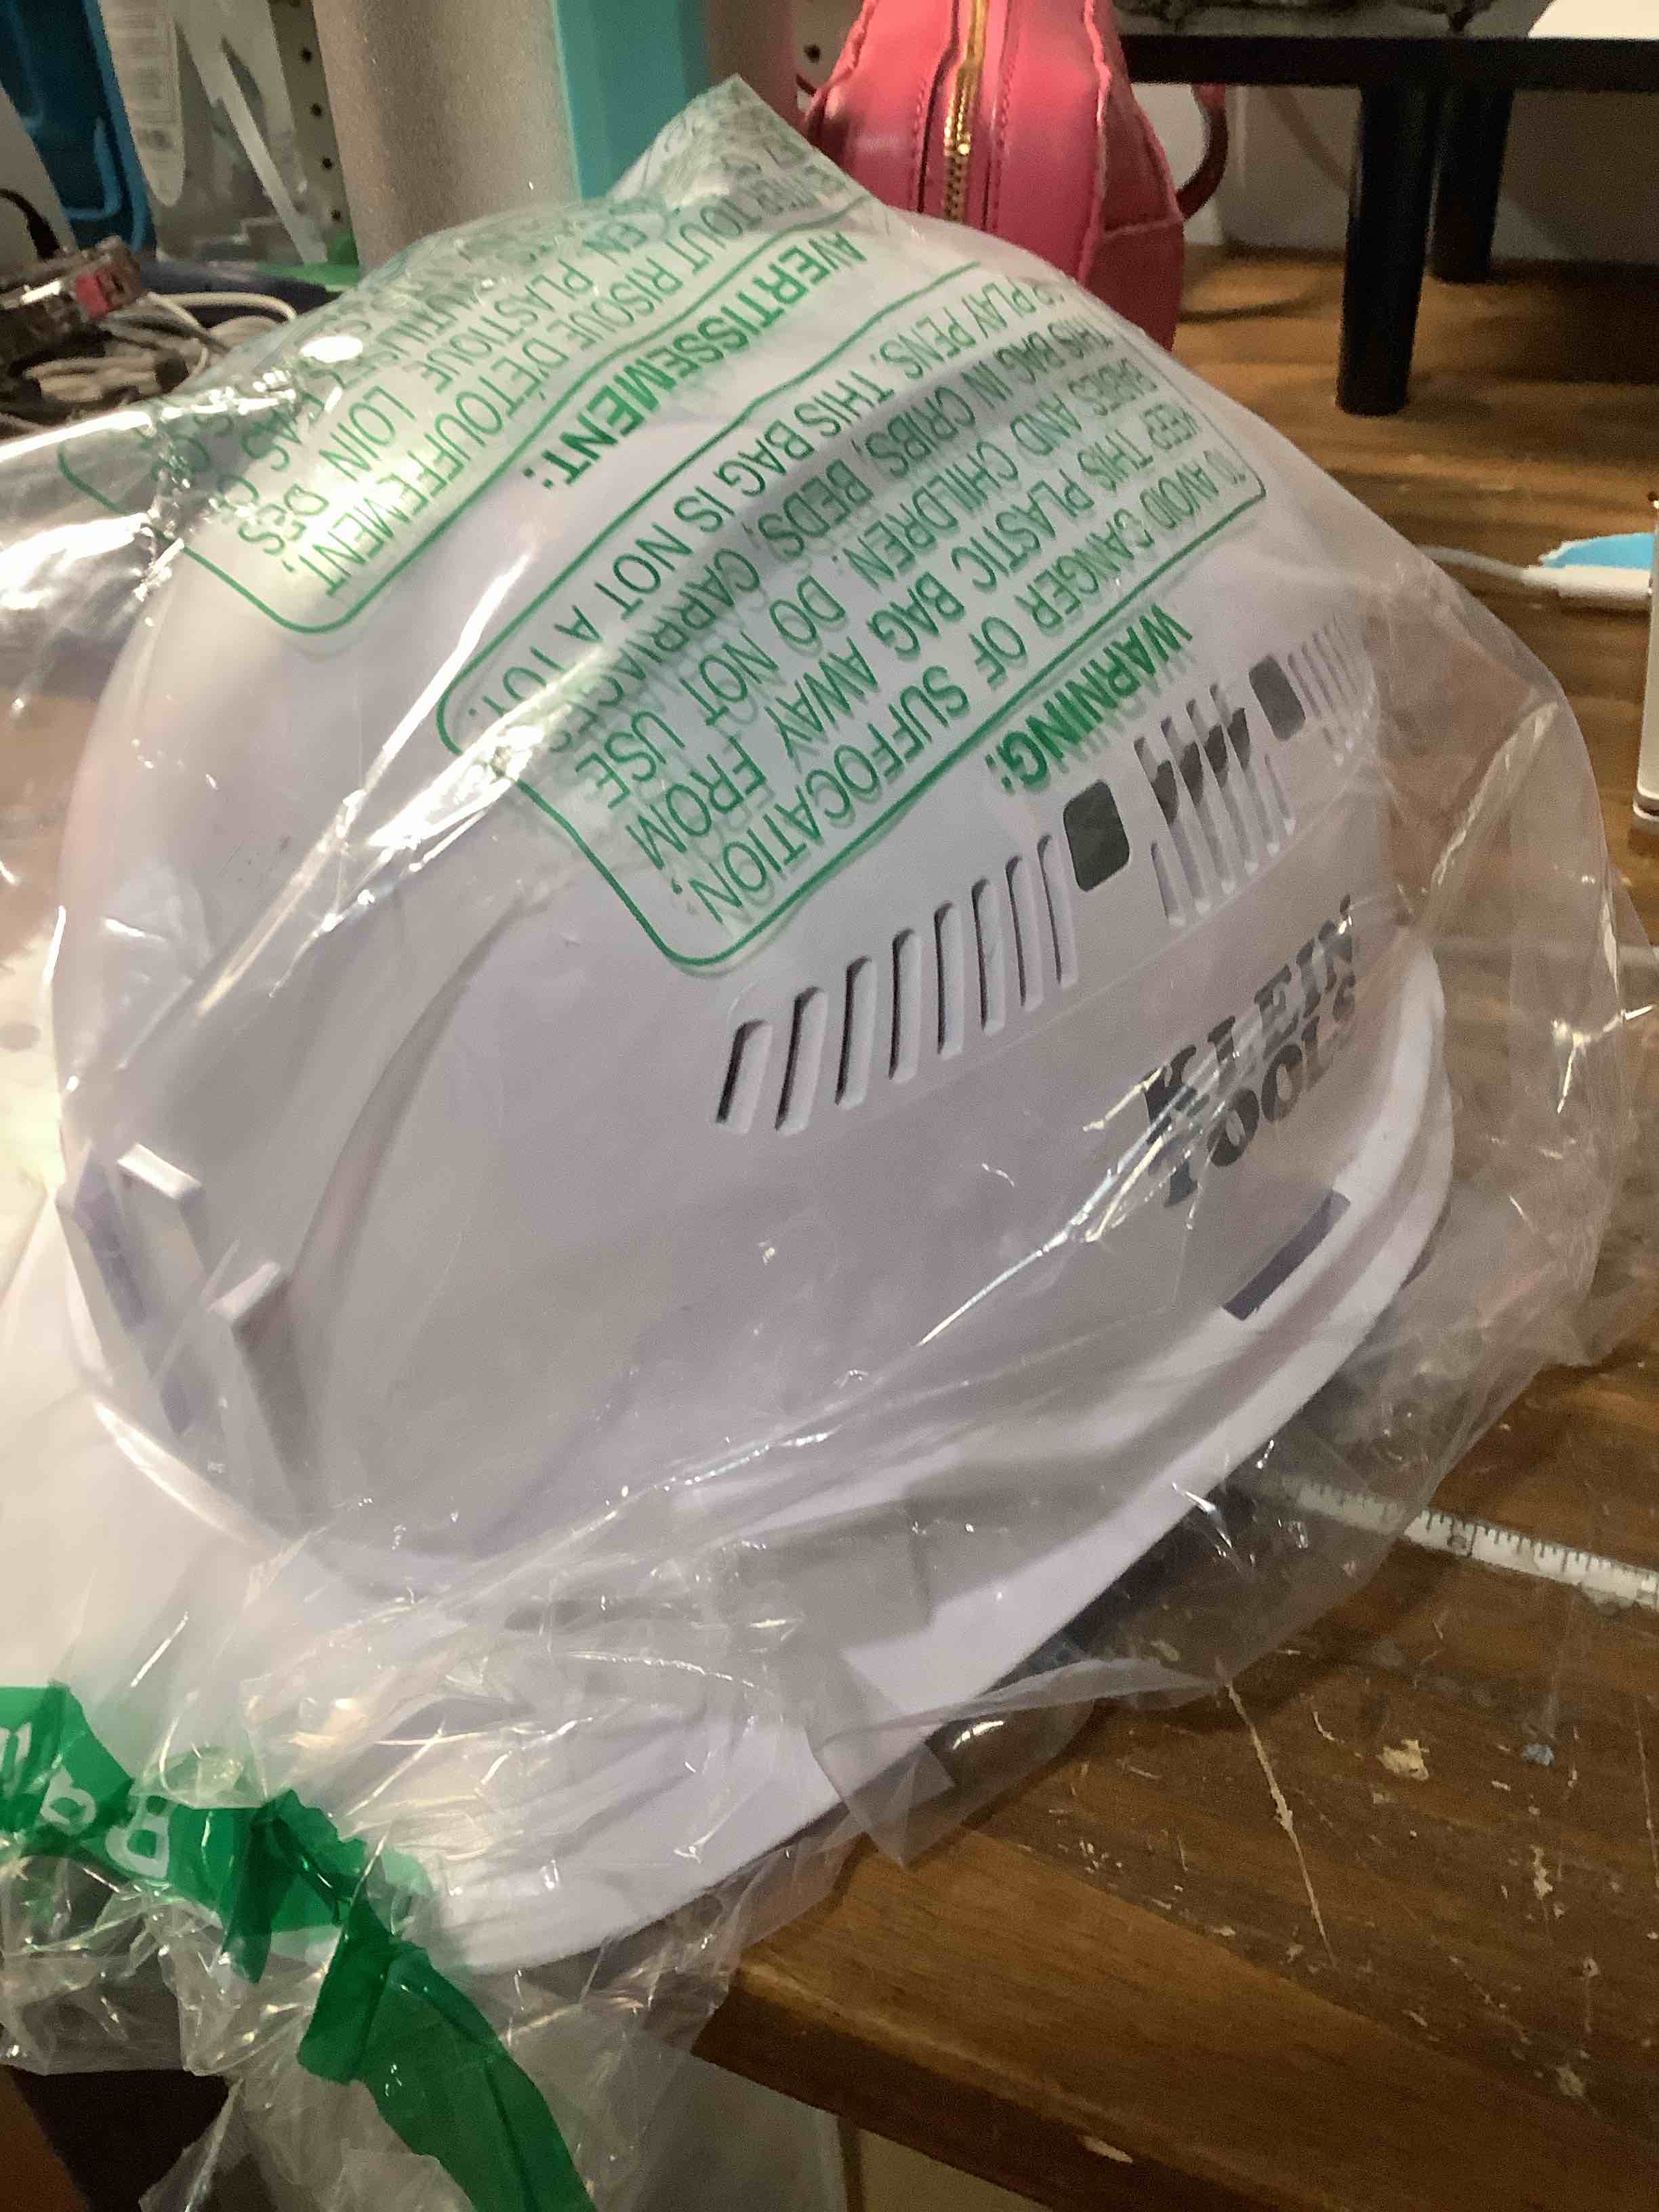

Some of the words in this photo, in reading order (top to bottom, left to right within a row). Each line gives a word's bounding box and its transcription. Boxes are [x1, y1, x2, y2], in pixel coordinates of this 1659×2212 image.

[665, 197, 763, 275] TOUT
[546, 257, 682, 352] RISQUE
[869, 306, 977, 380] PENS.
[960, 275, 1037, 339] PLAY
[524, 230, 867, 489] AVERTISSEMENT:
[795, 371, 895, 438] THIS
[958, 360, 1013, 409] IN
[317, 383, 416, 485] LOIN
[714, 419, 815, 496] BAG
[850, 386, 977, 479] CRIBS,
[1009, 391, 1083, 459] AND
[1076, 428, 1153, 497] THIS
[235, 483, 329, 558] DES
[673, 487, 735, 534] IS
[741, 457, 875, 562] BEDS,
[832, 443, 1017, 590] CHILDREN.
[950, 468, 1094, 592] PLASTIC
[1135, 457, 1221, 532] AVOID
[594, 523, 692, 620] NOT
[771, 573, 847, 644] DO
[865, 570, 968, 661] BAG
[554, 605, 603, 646] A
[968, 619, 1027, 691] OF
[678, 630, 781, 728] NOT
[764, 638, 882, 757] AWAY
[981, 604, 1193, 796] WARNING:
[573, 712, 685, 808] USE
[623, 736, 768, 871] FROM
[671, 669, 970, 923] SUFFOCATION,
